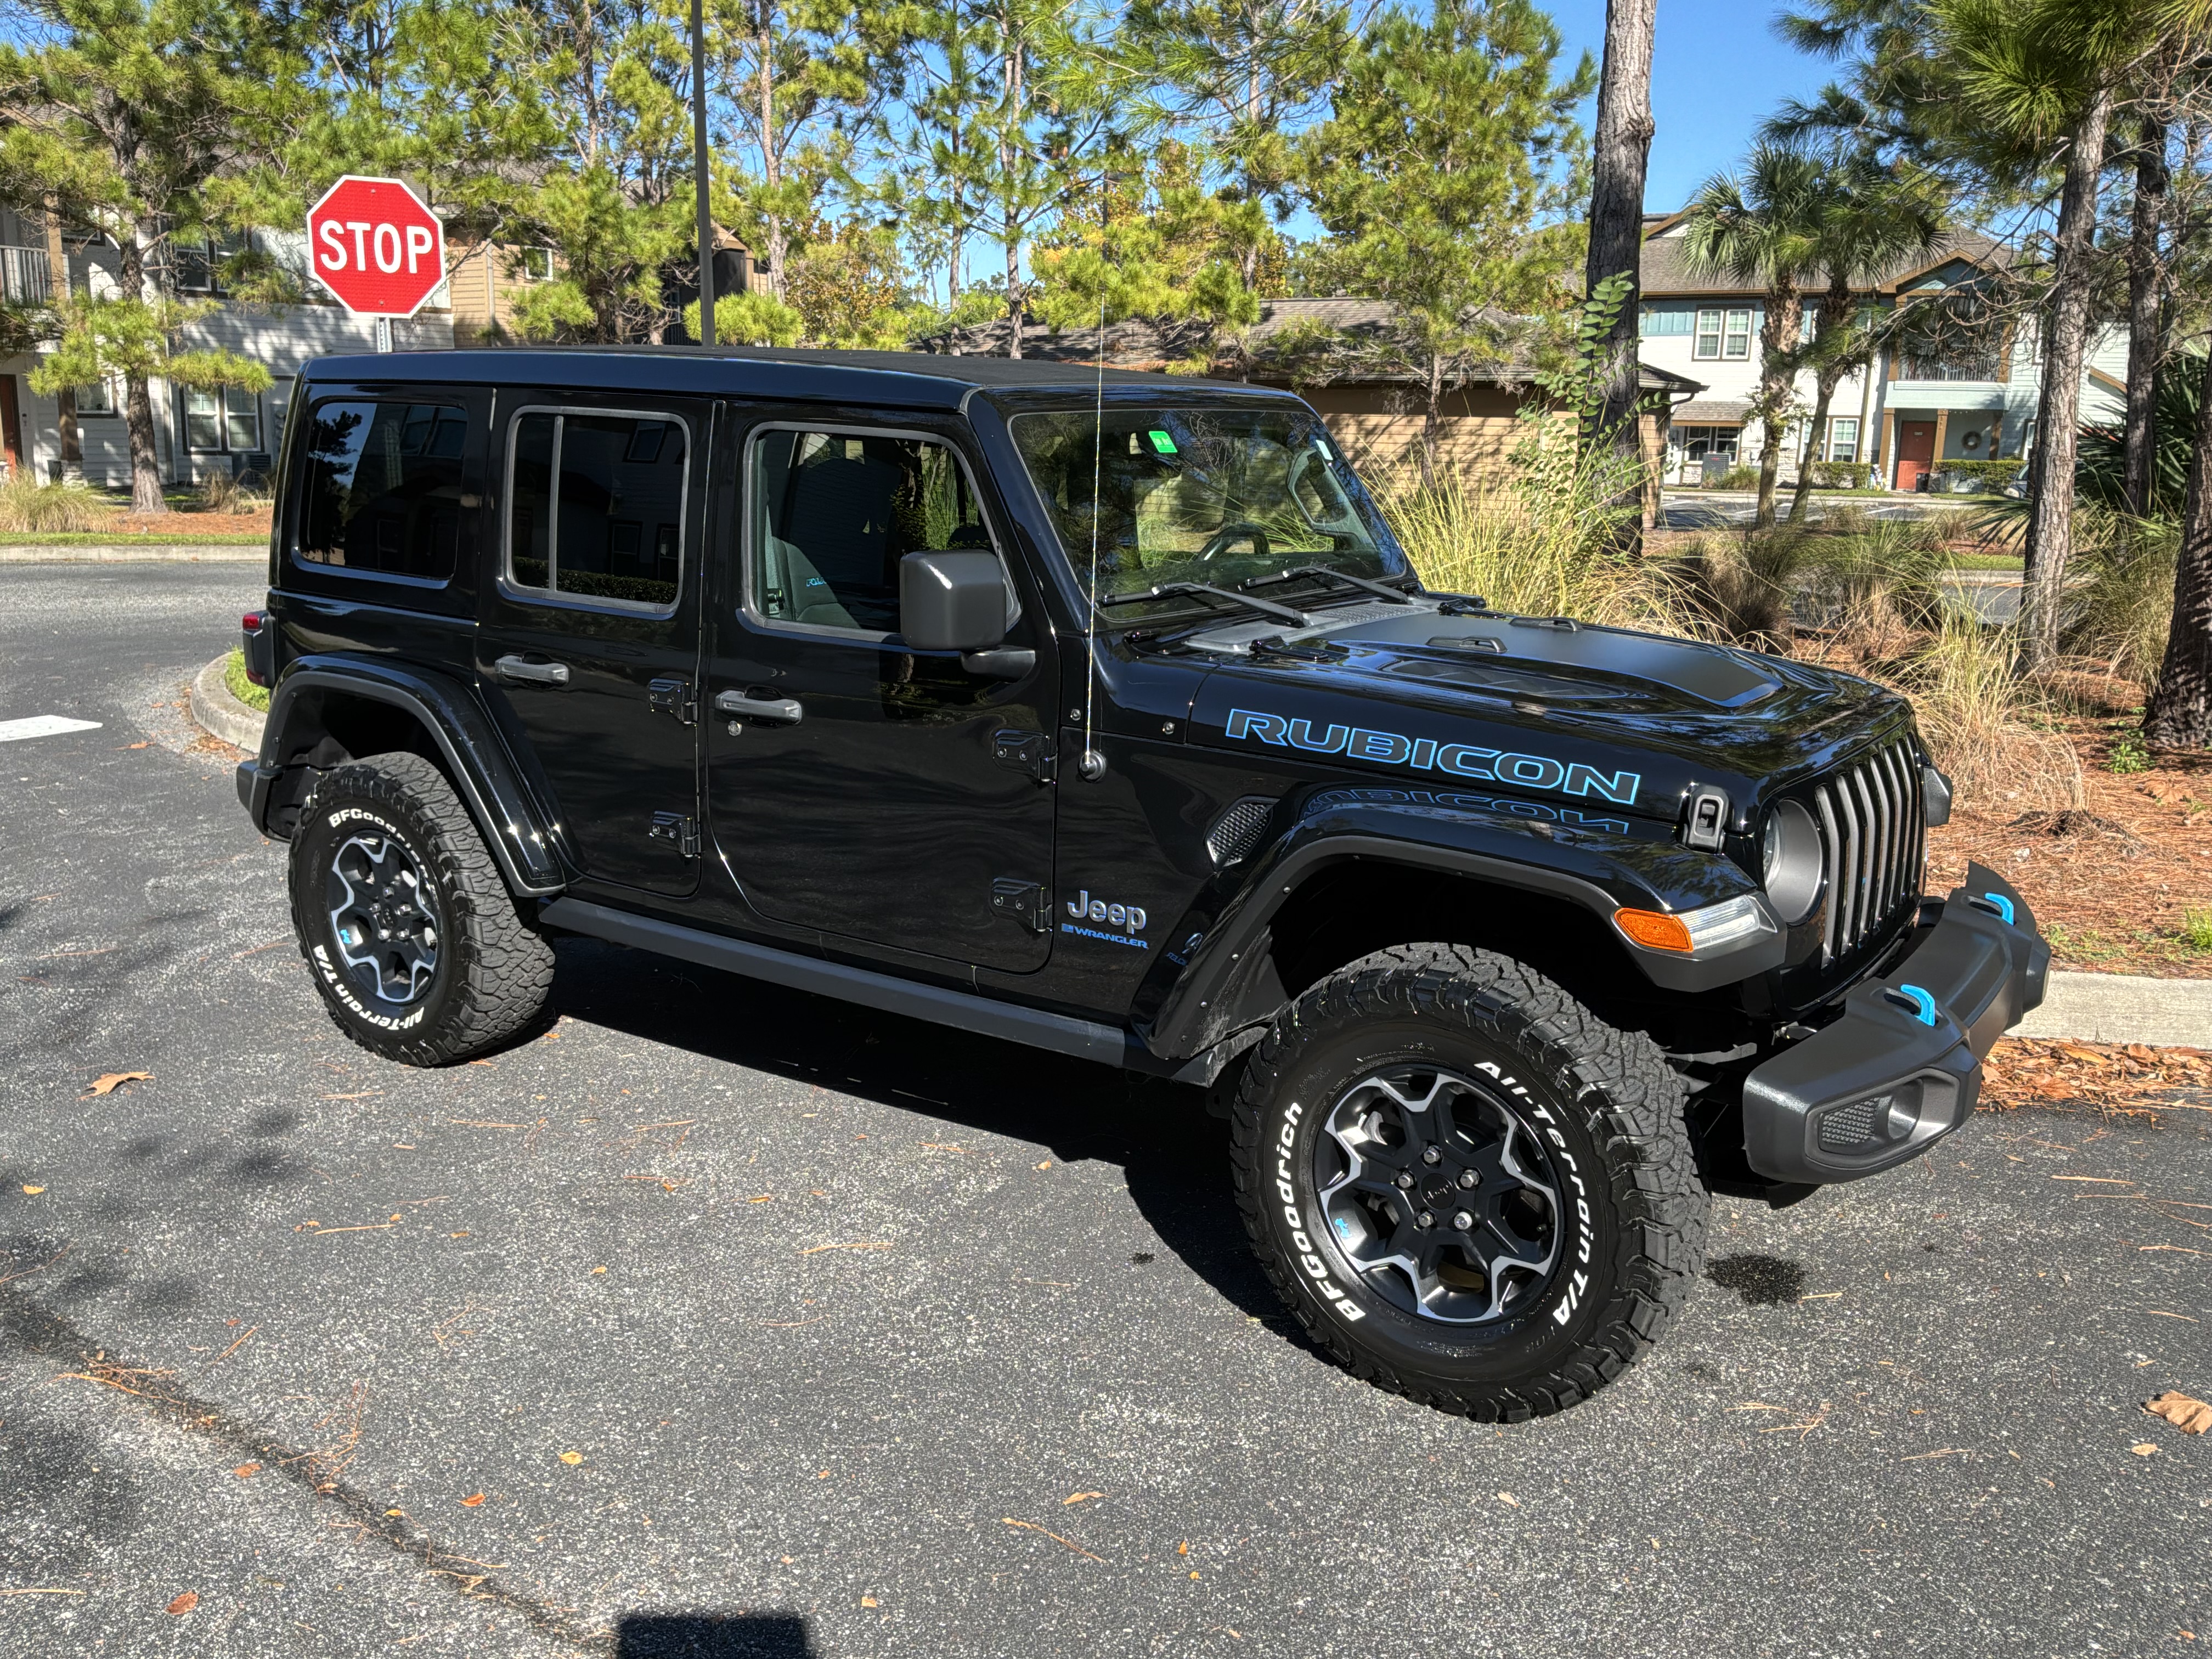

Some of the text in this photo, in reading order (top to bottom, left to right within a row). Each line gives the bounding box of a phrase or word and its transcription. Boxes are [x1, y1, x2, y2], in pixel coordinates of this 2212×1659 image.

[320, 220, 433, 274] STOP
[1225, 708, 1640, 805] RUBICON
[1067, 890, 1147, 934] Jeep
[1073, 926, 1149, 950] WRANGLER
[313, 945, 425, 1030] All-Terrain T/A
[1276, 1102, 1365, 1321] BFGoodrich
[1475, 1062, 1593, 1325] All-Terrain T/A
